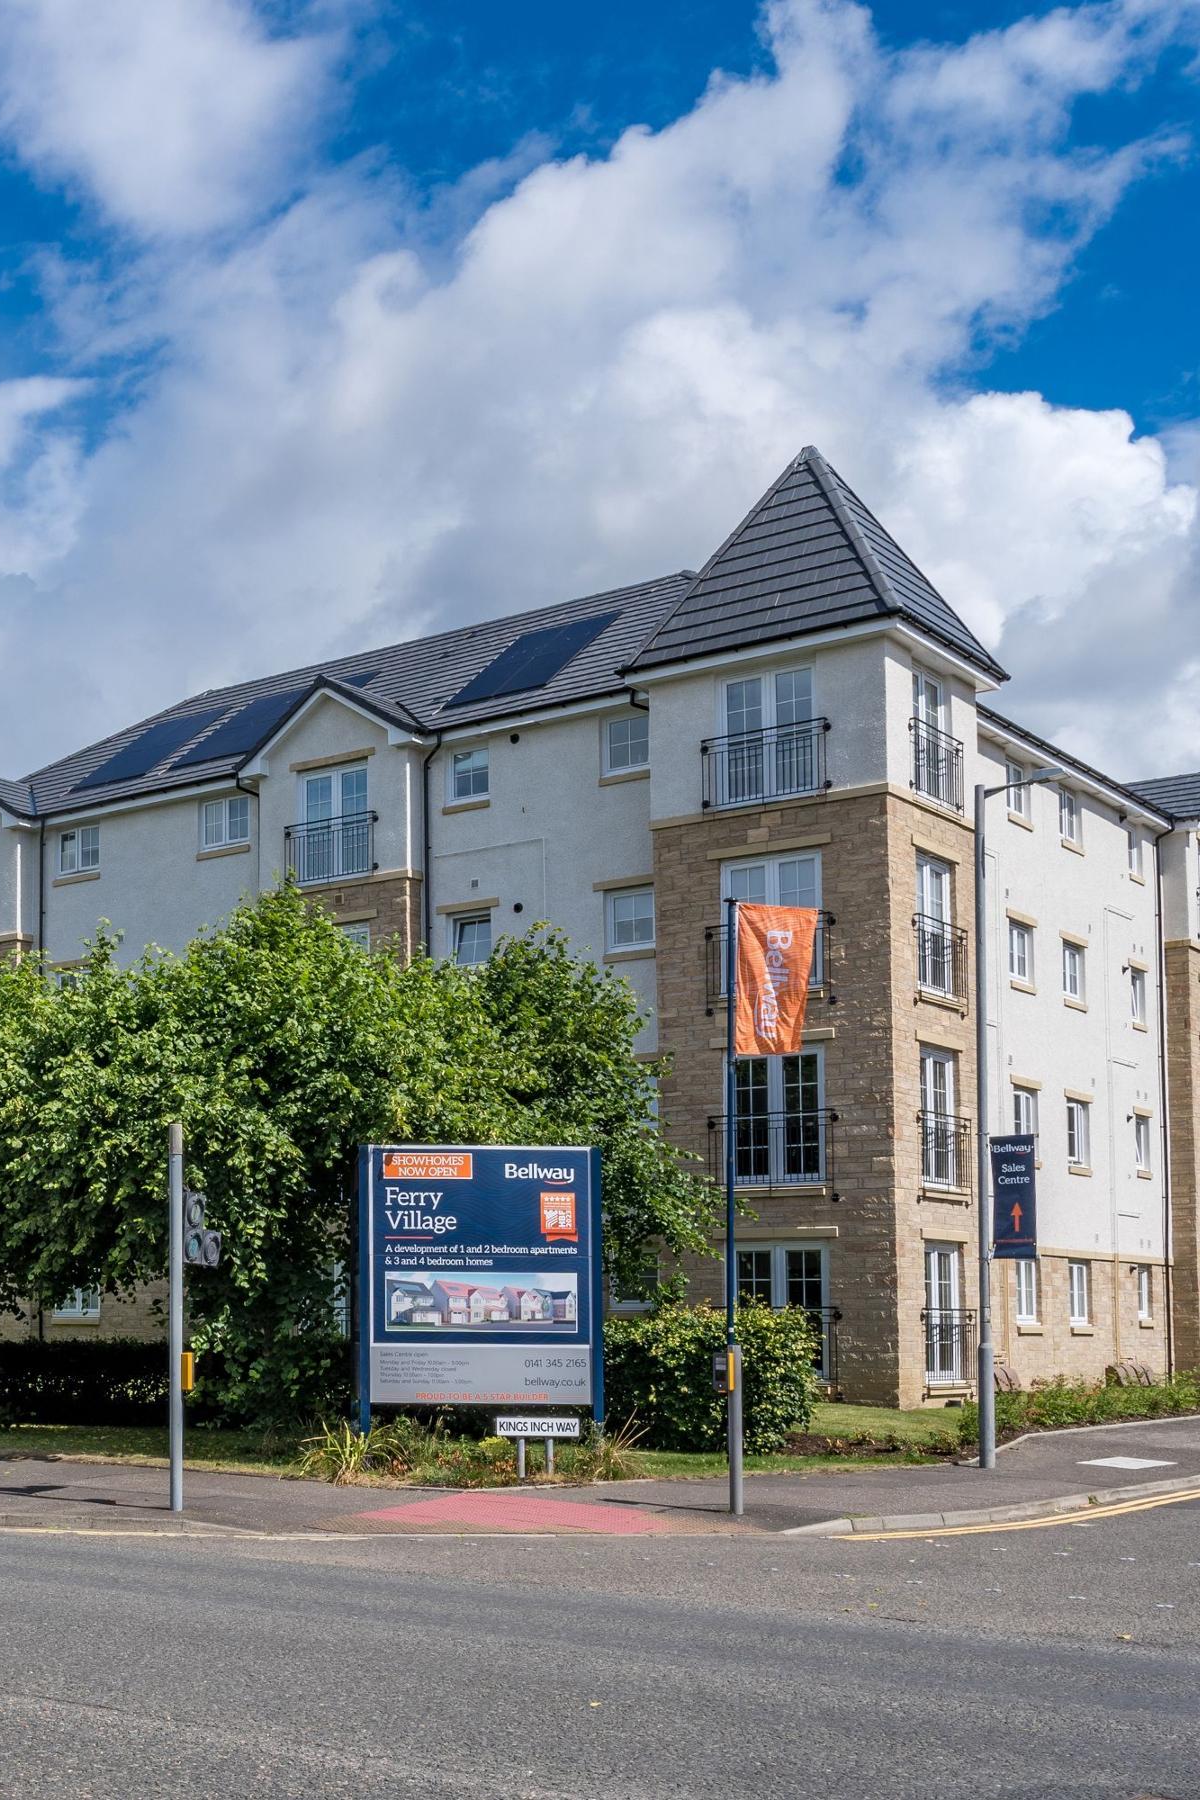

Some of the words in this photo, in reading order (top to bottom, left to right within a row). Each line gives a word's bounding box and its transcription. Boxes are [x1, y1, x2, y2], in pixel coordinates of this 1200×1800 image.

[755, 930, 793, 1039] Bellway
[994, 1144, 1031, 1153] Bellway
[391, 1156, 464, 1166] SHOWHOMES
[398, 1166, 427, 1176] NOW
[428, 1166, 458, 1176] OPEN
[1002, 1163, 1026, 1172] Sales
[504, 1163, 574, 1184] Bellway
[998, 1176, 1030, 1184] Centre
[385, 1186, 443, 1210] Ferry
[385, 1210, 456, 1234] Village
[385, 1244, 393, 1252] A
[394, 1244, 448, 1254] development
[449, 1244, 458, 1253] of
[460, 1244, 464, 1253] 1
[466, 1244, 482, 1253] and
[484, 1244, 490, 1253] 2
[491, 1244, 528, 1254] bedroom
[530, 1246, 578, 1255] apartments
[385, 1256, 392, 1265] &
[394, 1256, 400, 1265] 3
[401, 1256, 417, 1265] and
[419, 1256, 425, 1265] 4
[426, 1256, 464, 1266] bedroom
[466, 1257, 493, 1266] homes
[524, 1359, 542, 1367] 0141
[546, 1359, 563, 1367] 345
[566, 1359, 586, 1367] 2165
[524, 1378, 586, 1388] bellway.co.uk
[415, 1392, 445, 1400] PROUD
[448, 1392, 459, 1400] TO
[499, 1421, 528, 1432] KINGS
[530, 1422, 553, 1432] INCH
[556, 1422, 577, 1432] WAY
